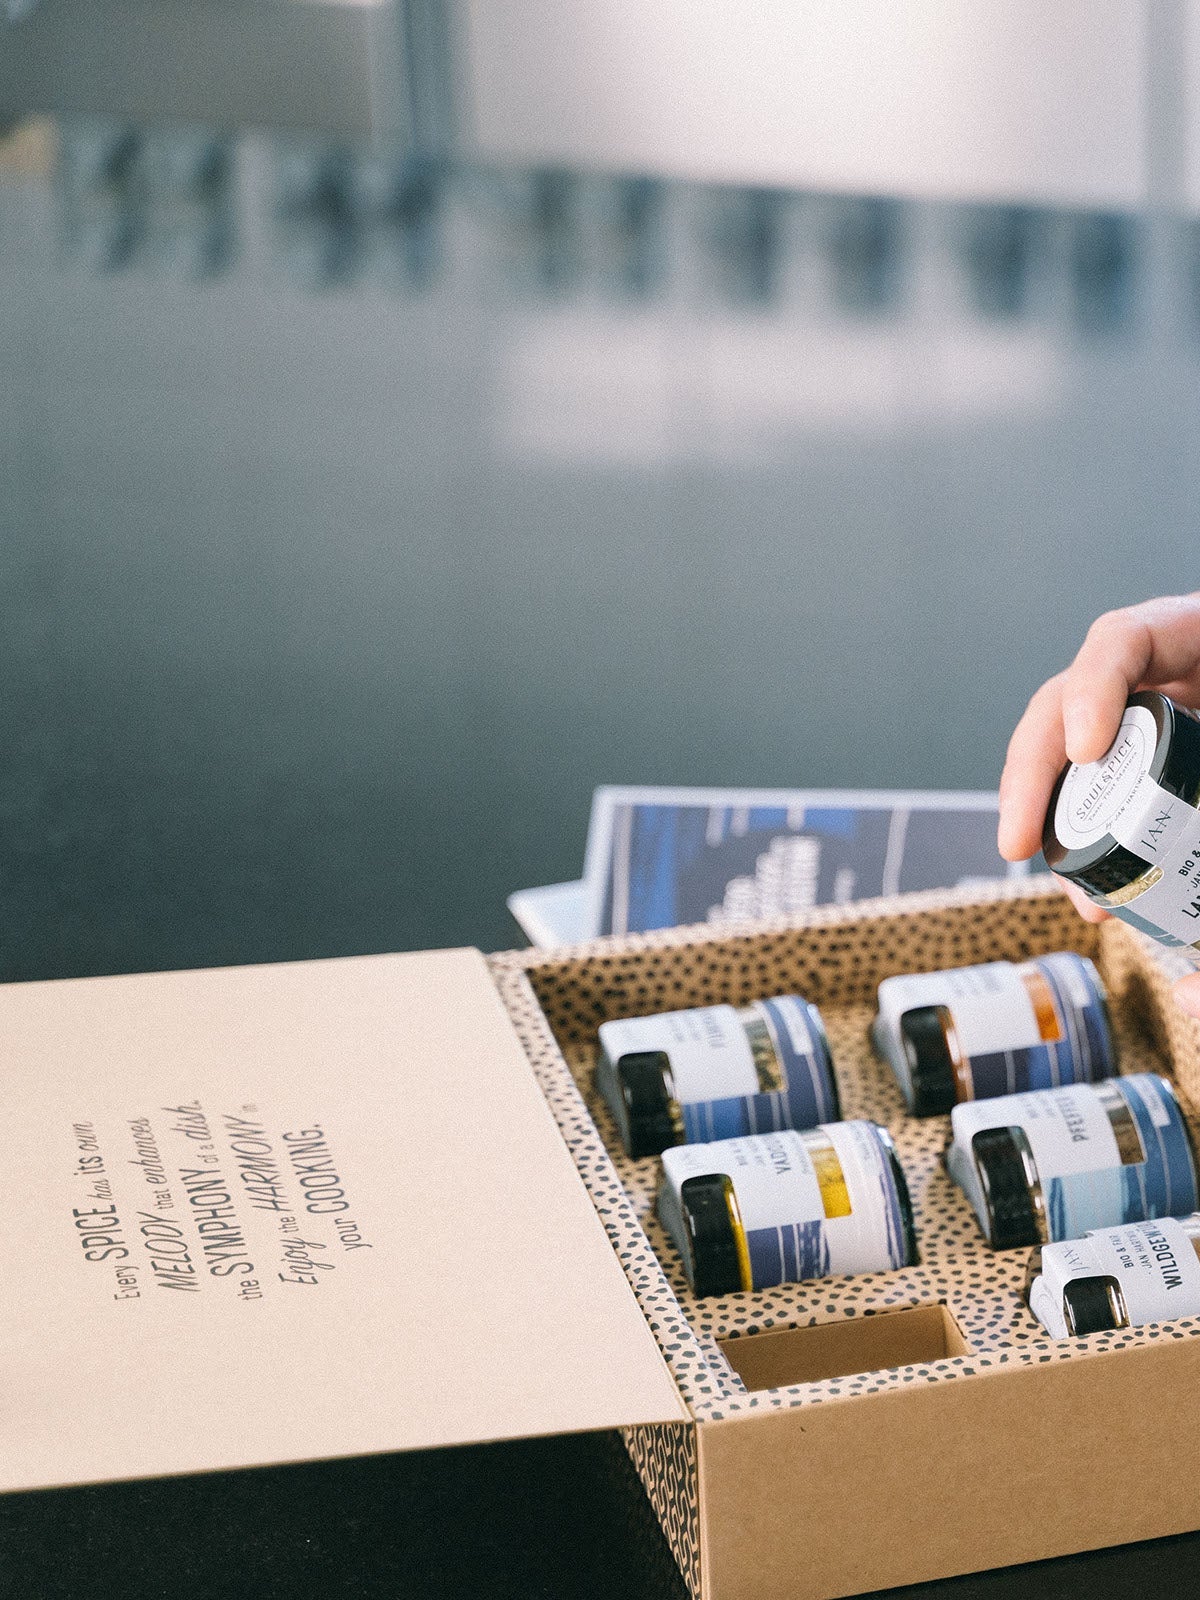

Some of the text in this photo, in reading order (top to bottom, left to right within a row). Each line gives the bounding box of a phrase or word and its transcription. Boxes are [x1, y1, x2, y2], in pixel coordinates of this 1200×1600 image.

[1141, 802, 1175, 852] JAN
[1178, 860, 1195, 877] BIO
[196, 1154, 218, 1164] of
[222, 1114, 293, 1212] HARMONY
[72, 1120, 140, 1301] Every SPICE has its own
[127, 1117, 201, 1292] MELODY that enhances
[282, 1123, 373, 1251] your COOKING.
[179, 1168, 254, 1277] SYMPHONY
[278, 1216, 299, 1233] the
[278, 1237, 336, 1285] Enjoy
[1120, 1254, 1135, 1269] BIO
[1138, 1254, 1152, 1270] JAN
[237, 1279, 263, 1301] the
